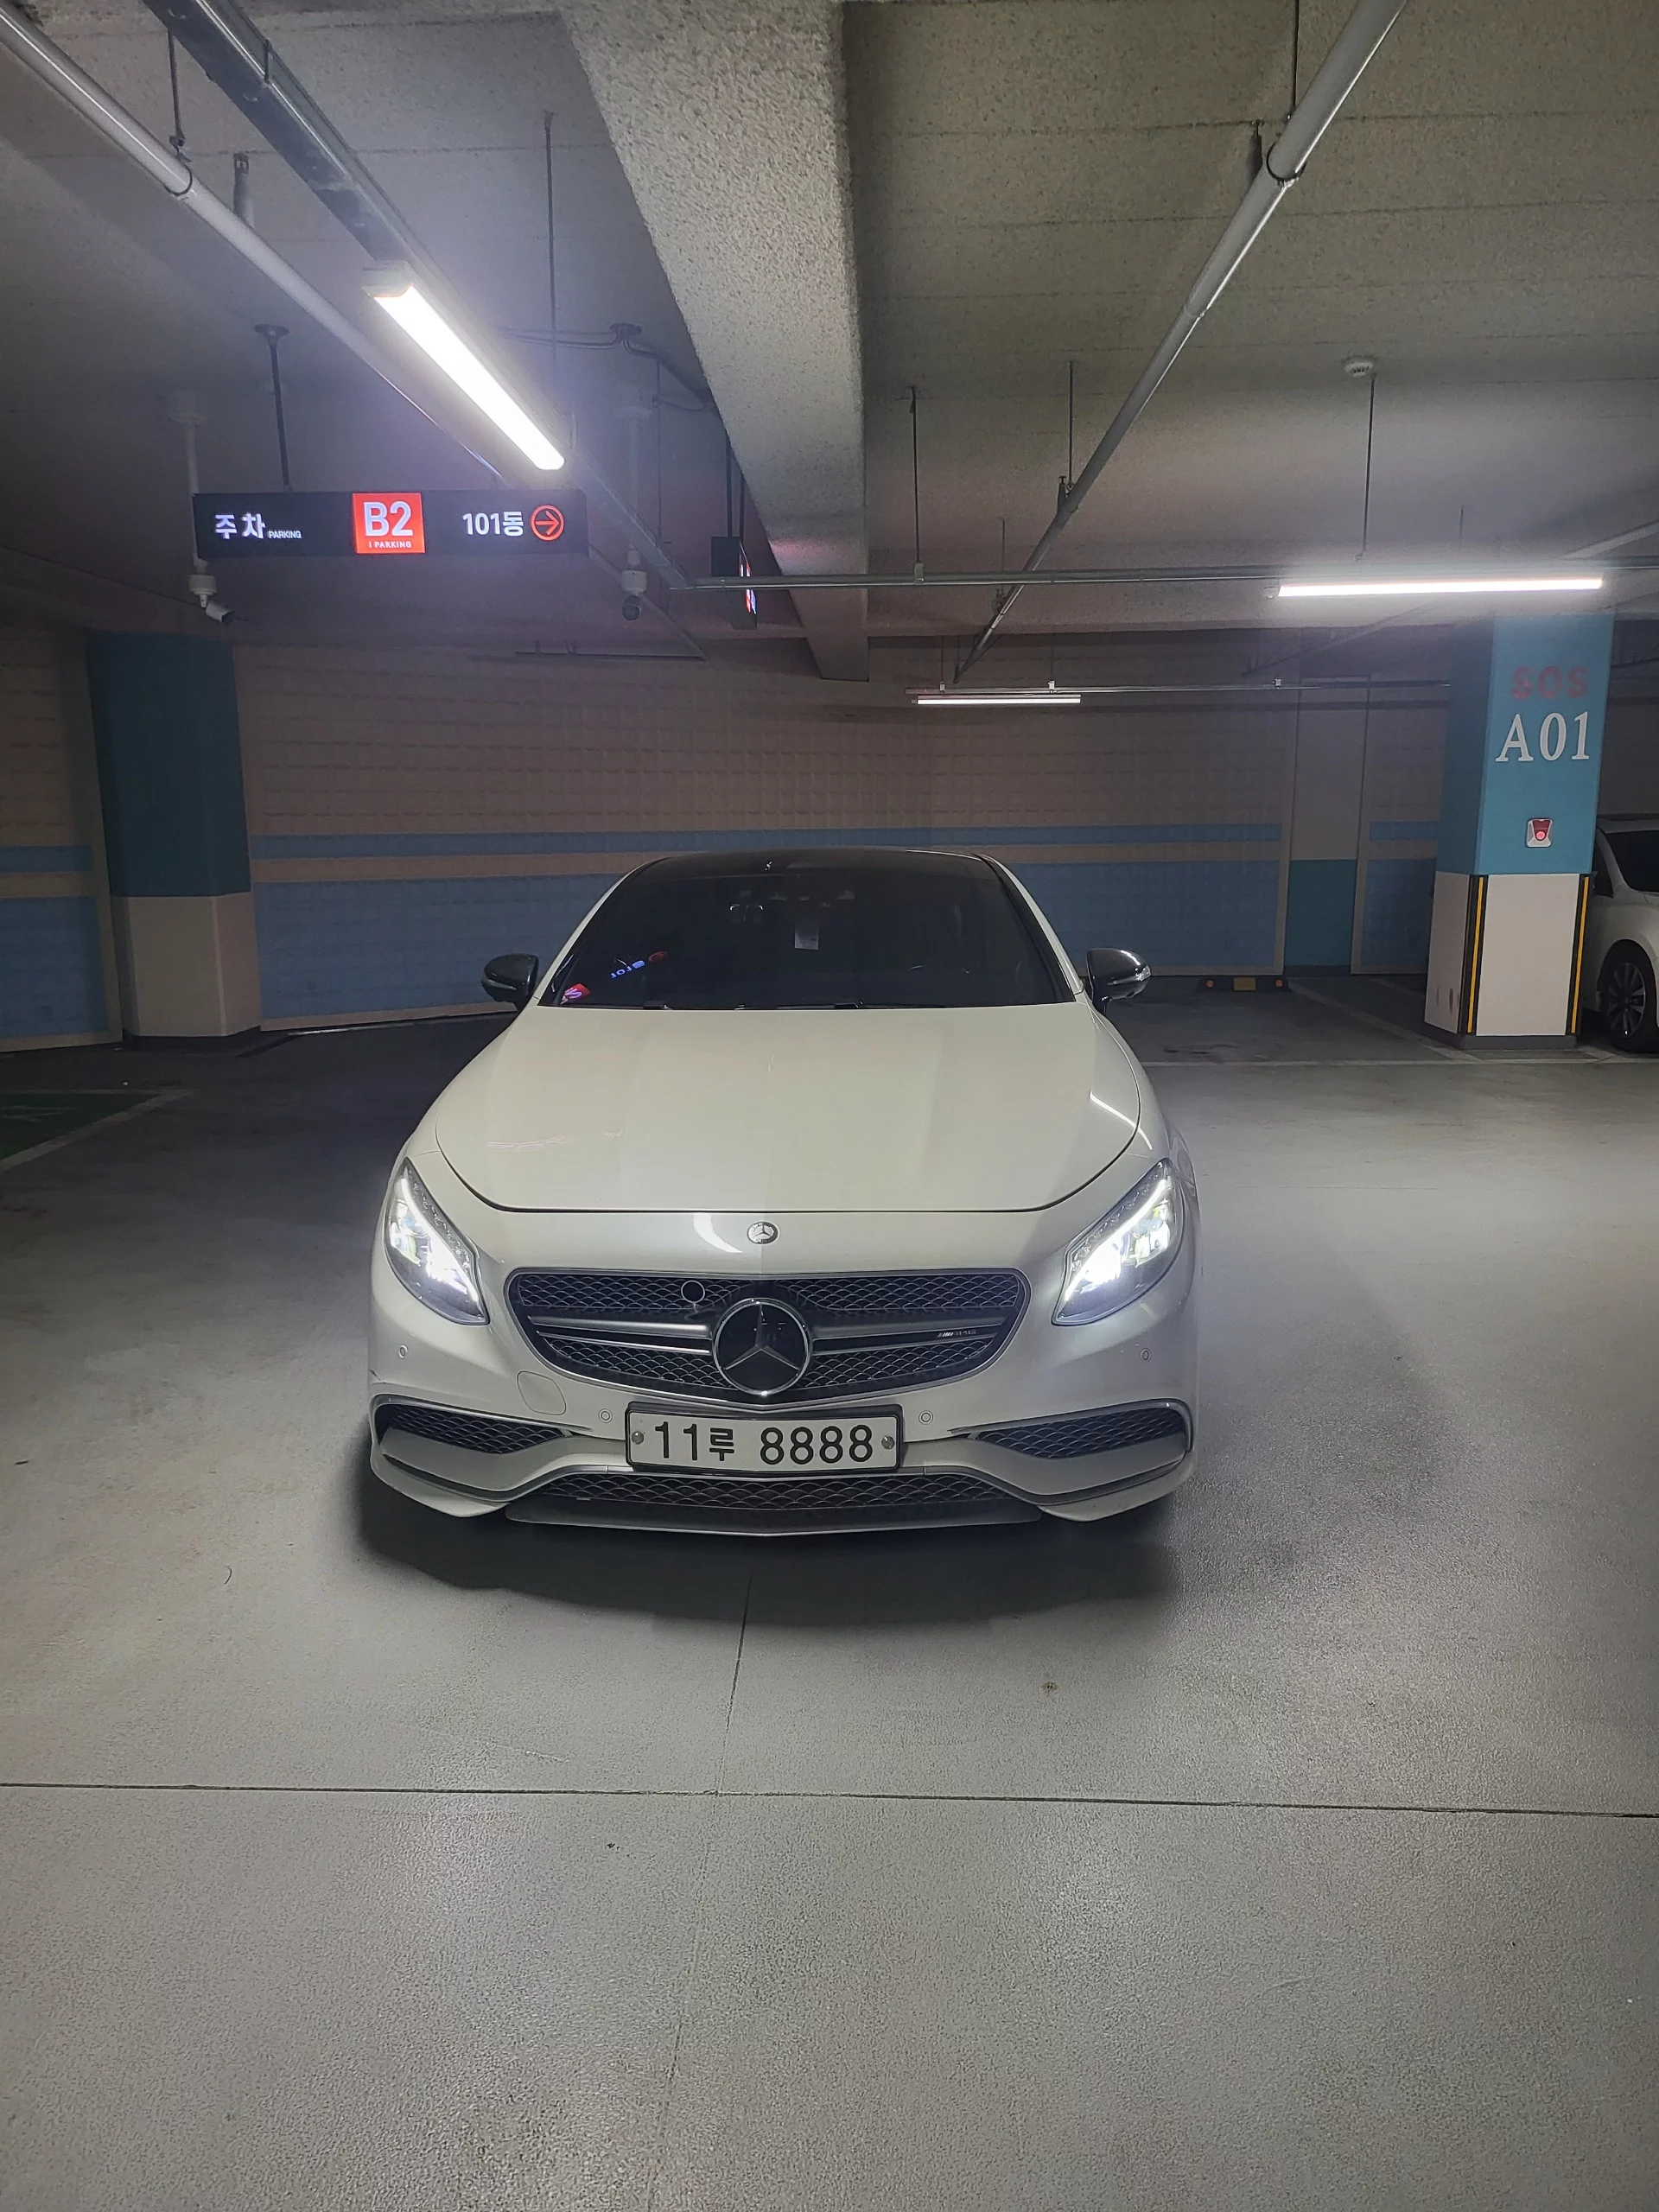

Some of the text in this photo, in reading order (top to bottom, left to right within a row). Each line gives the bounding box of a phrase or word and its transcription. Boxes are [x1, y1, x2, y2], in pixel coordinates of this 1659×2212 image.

[268, 530, 302, 539] PARKING
[364, 500, 414, 537] B2
[462, 511, 524, 537] 101동
[1512, 665, 1588, 699] SOS
[1496, 712, 1589, 761] A01
[654, 1421, 874, 1465] 11루 8888
